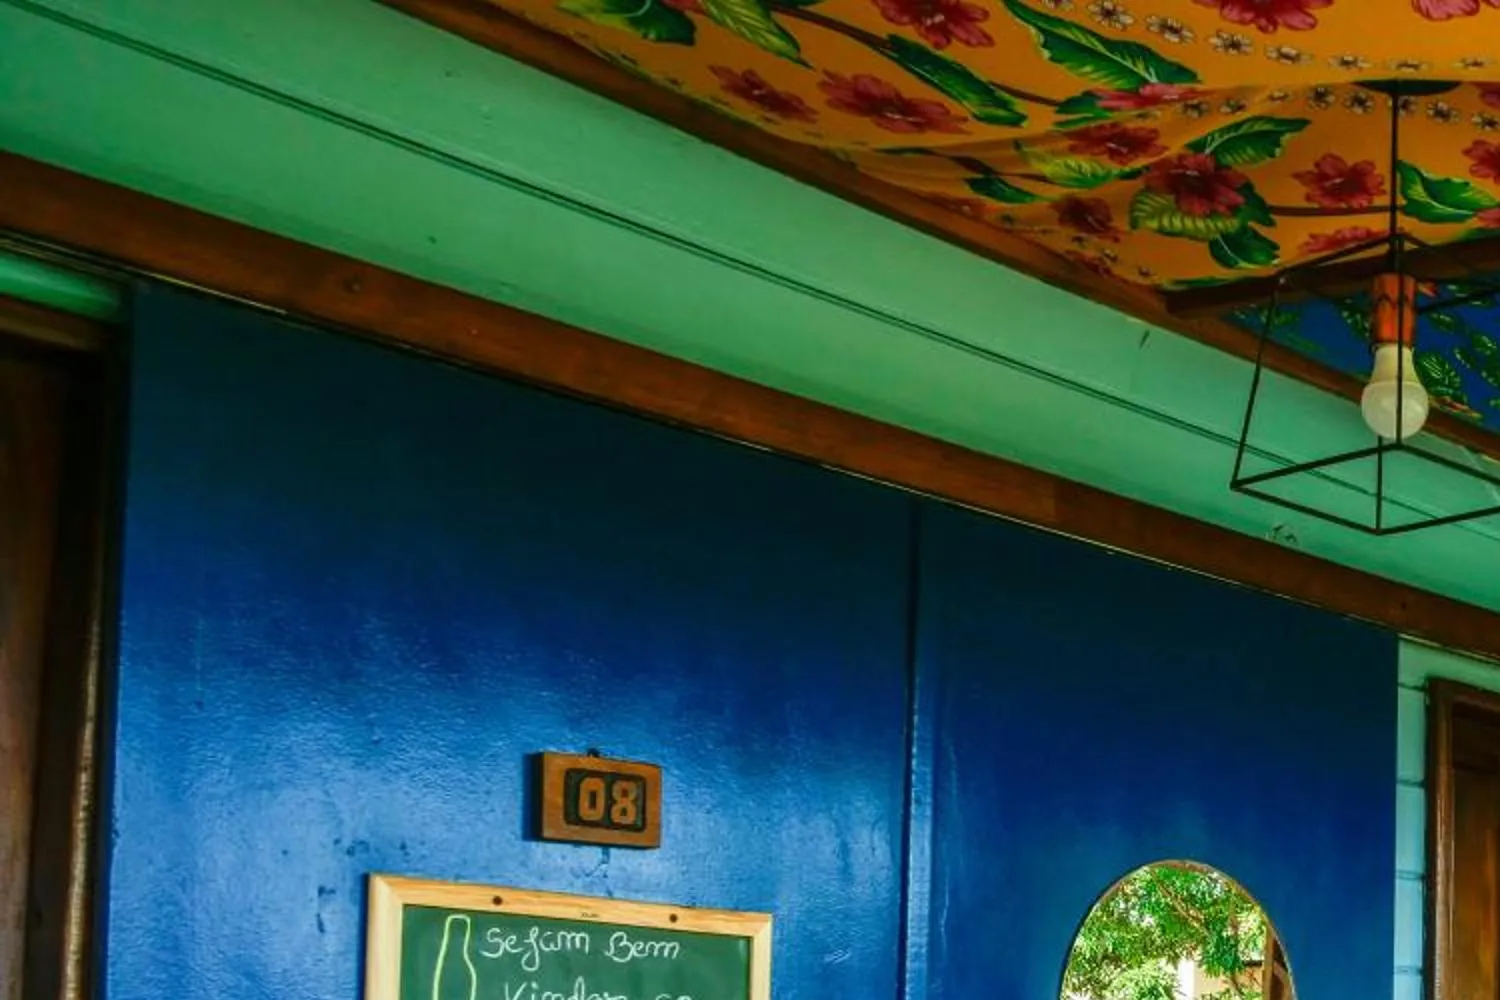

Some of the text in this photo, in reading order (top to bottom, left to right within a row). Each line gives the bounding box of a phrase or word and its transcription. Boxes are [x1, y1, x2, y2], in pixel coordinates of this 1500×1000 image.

[578, 776, 638, 825] 08
[479, 926, 680, 972] Sejam Bem
